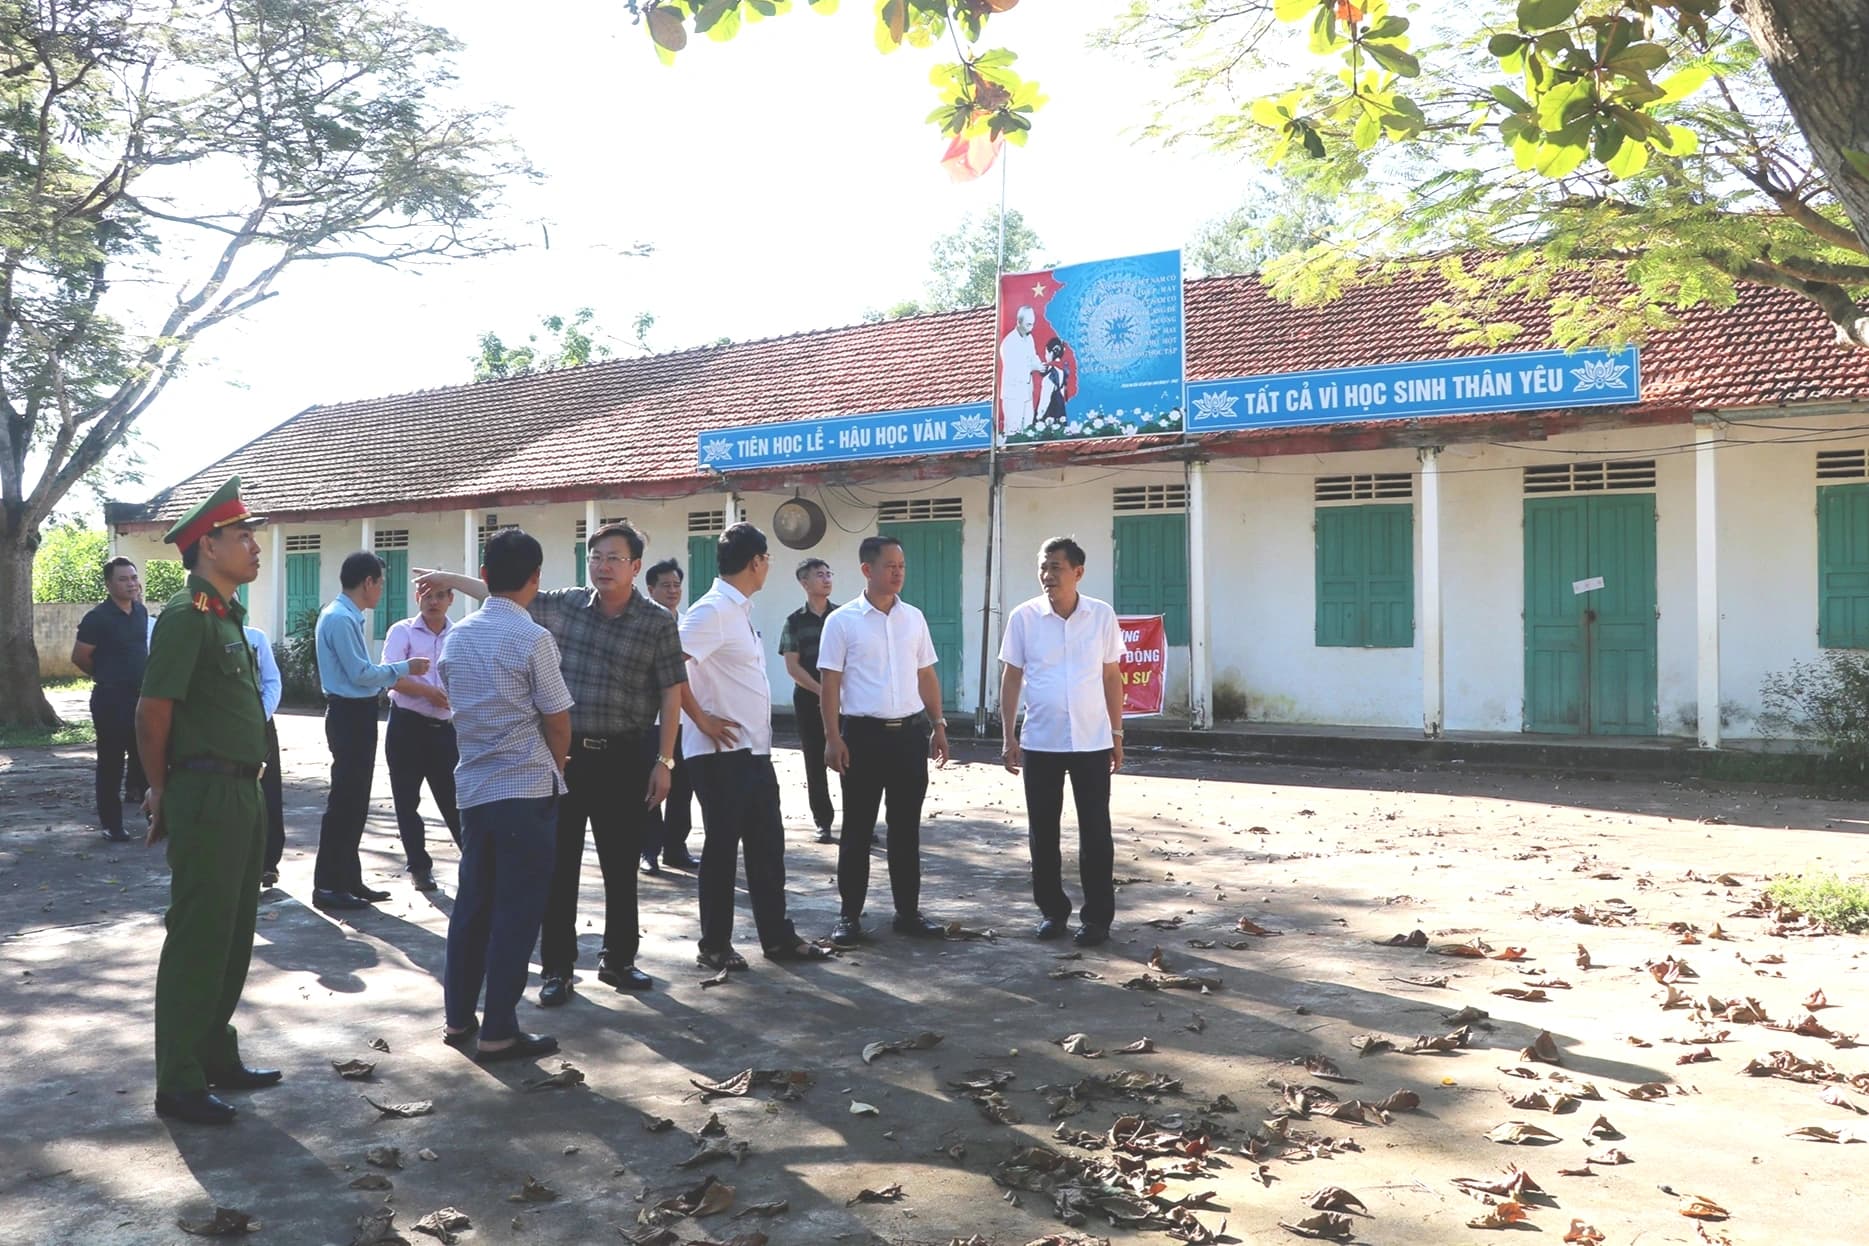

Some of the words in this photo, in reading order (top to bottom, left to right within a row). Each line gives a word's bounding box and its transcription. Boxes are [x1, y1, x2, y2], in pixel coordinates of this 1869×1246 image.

[1244, 383, 1280, 415] TẤT
[1285, 380, 1314, 412] CẢ
[1318, 381, 1339, 410] VÌ
[1344, 381, 1388, 411] HỌC
[1393, 377, 1446, 404] SINH
[1452, 368, 1513, 399] THÂN
[1518, 364, 1564, 394] YÊU
[773, 434, 803, 458] HỌC
[806, 425, 825, 452] LỄ
[839, 425, 871, 452] HẬU
[875, 424, 908, 449] HỌC
[912, 418, 947, 442] VĂN
[1125, 647, 1160, 666] ĐỘNG
[1132, 669, 1153, 687] SỰ
